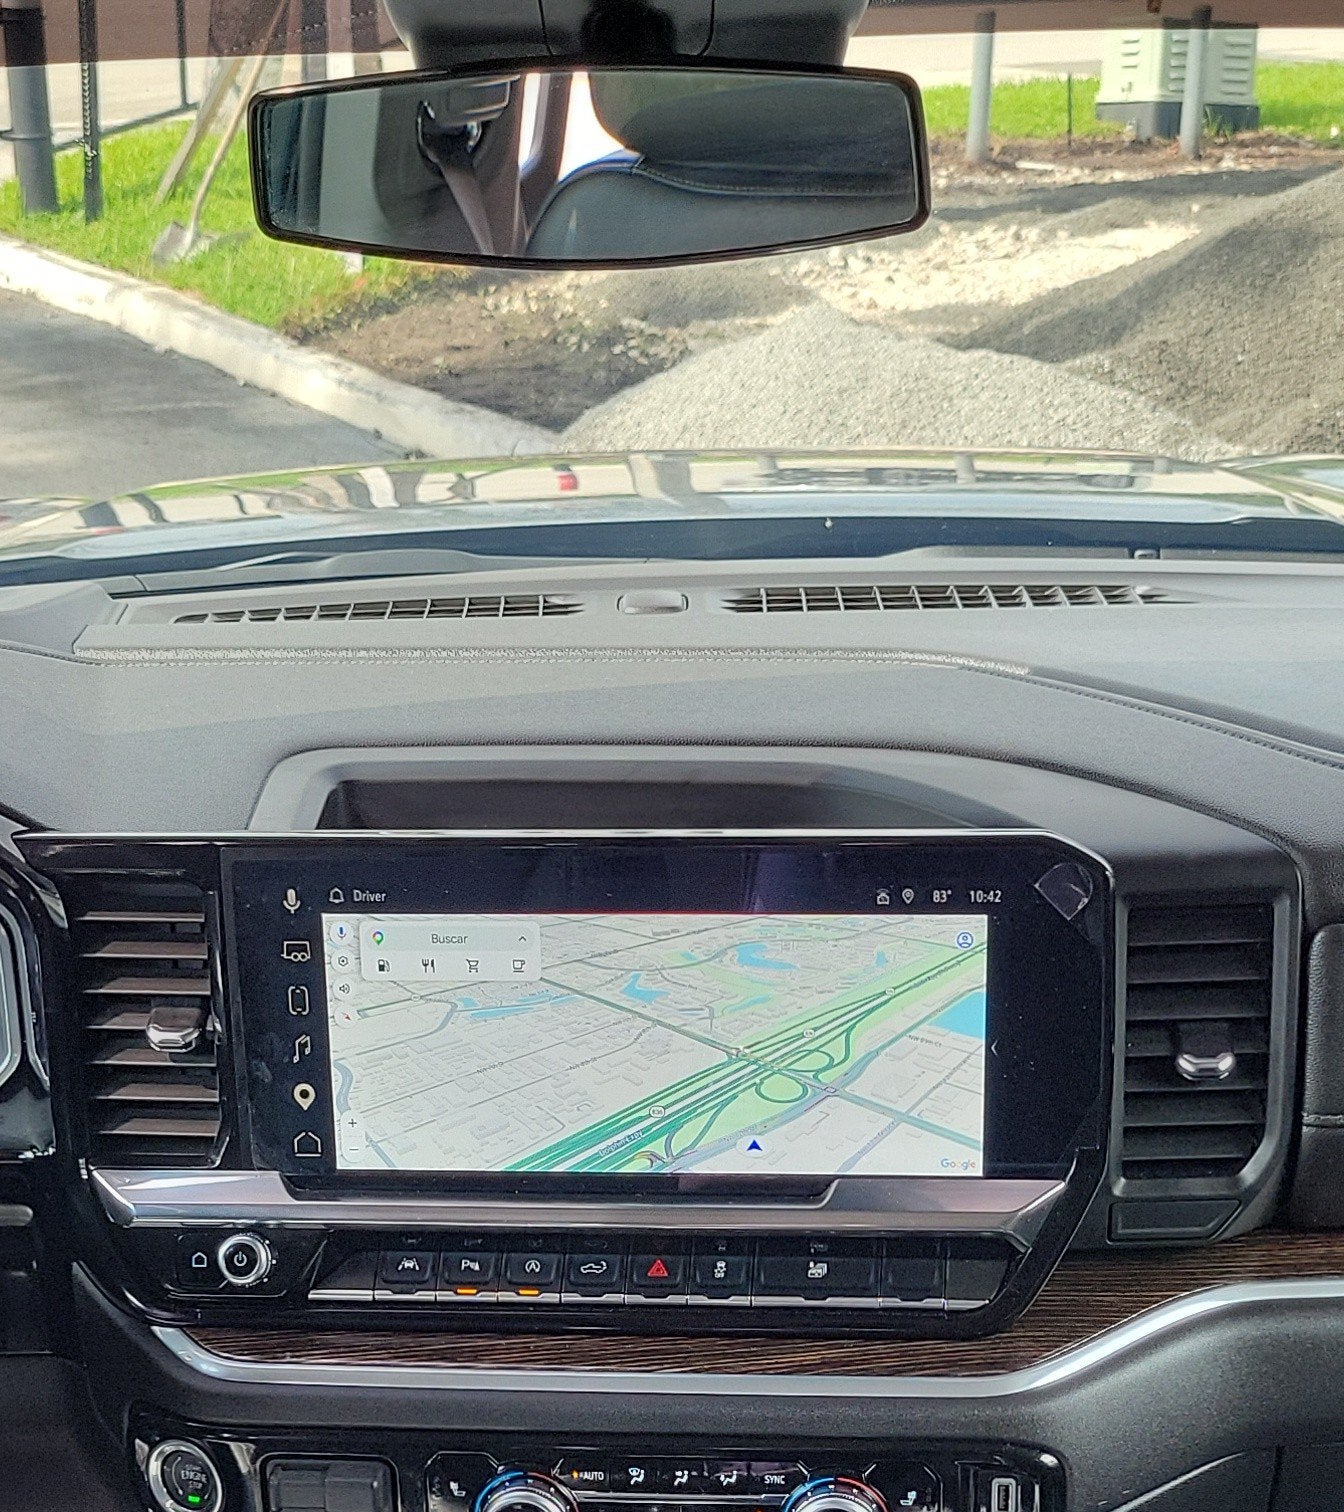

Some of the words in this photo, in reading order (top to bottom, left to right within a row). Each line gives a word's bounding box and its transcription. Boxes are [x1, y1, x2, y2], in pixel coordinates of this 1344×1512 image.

[353, 889, 386, 902] Driver
[969, 889, 1002, 903] 10:42
[431, 932, 469, 945] Buscar
[940, 1157, 977, 1170] Google
[582, 1471, 604, 1481] AUTO
[764, 1474, 786, 1485] SYNC
